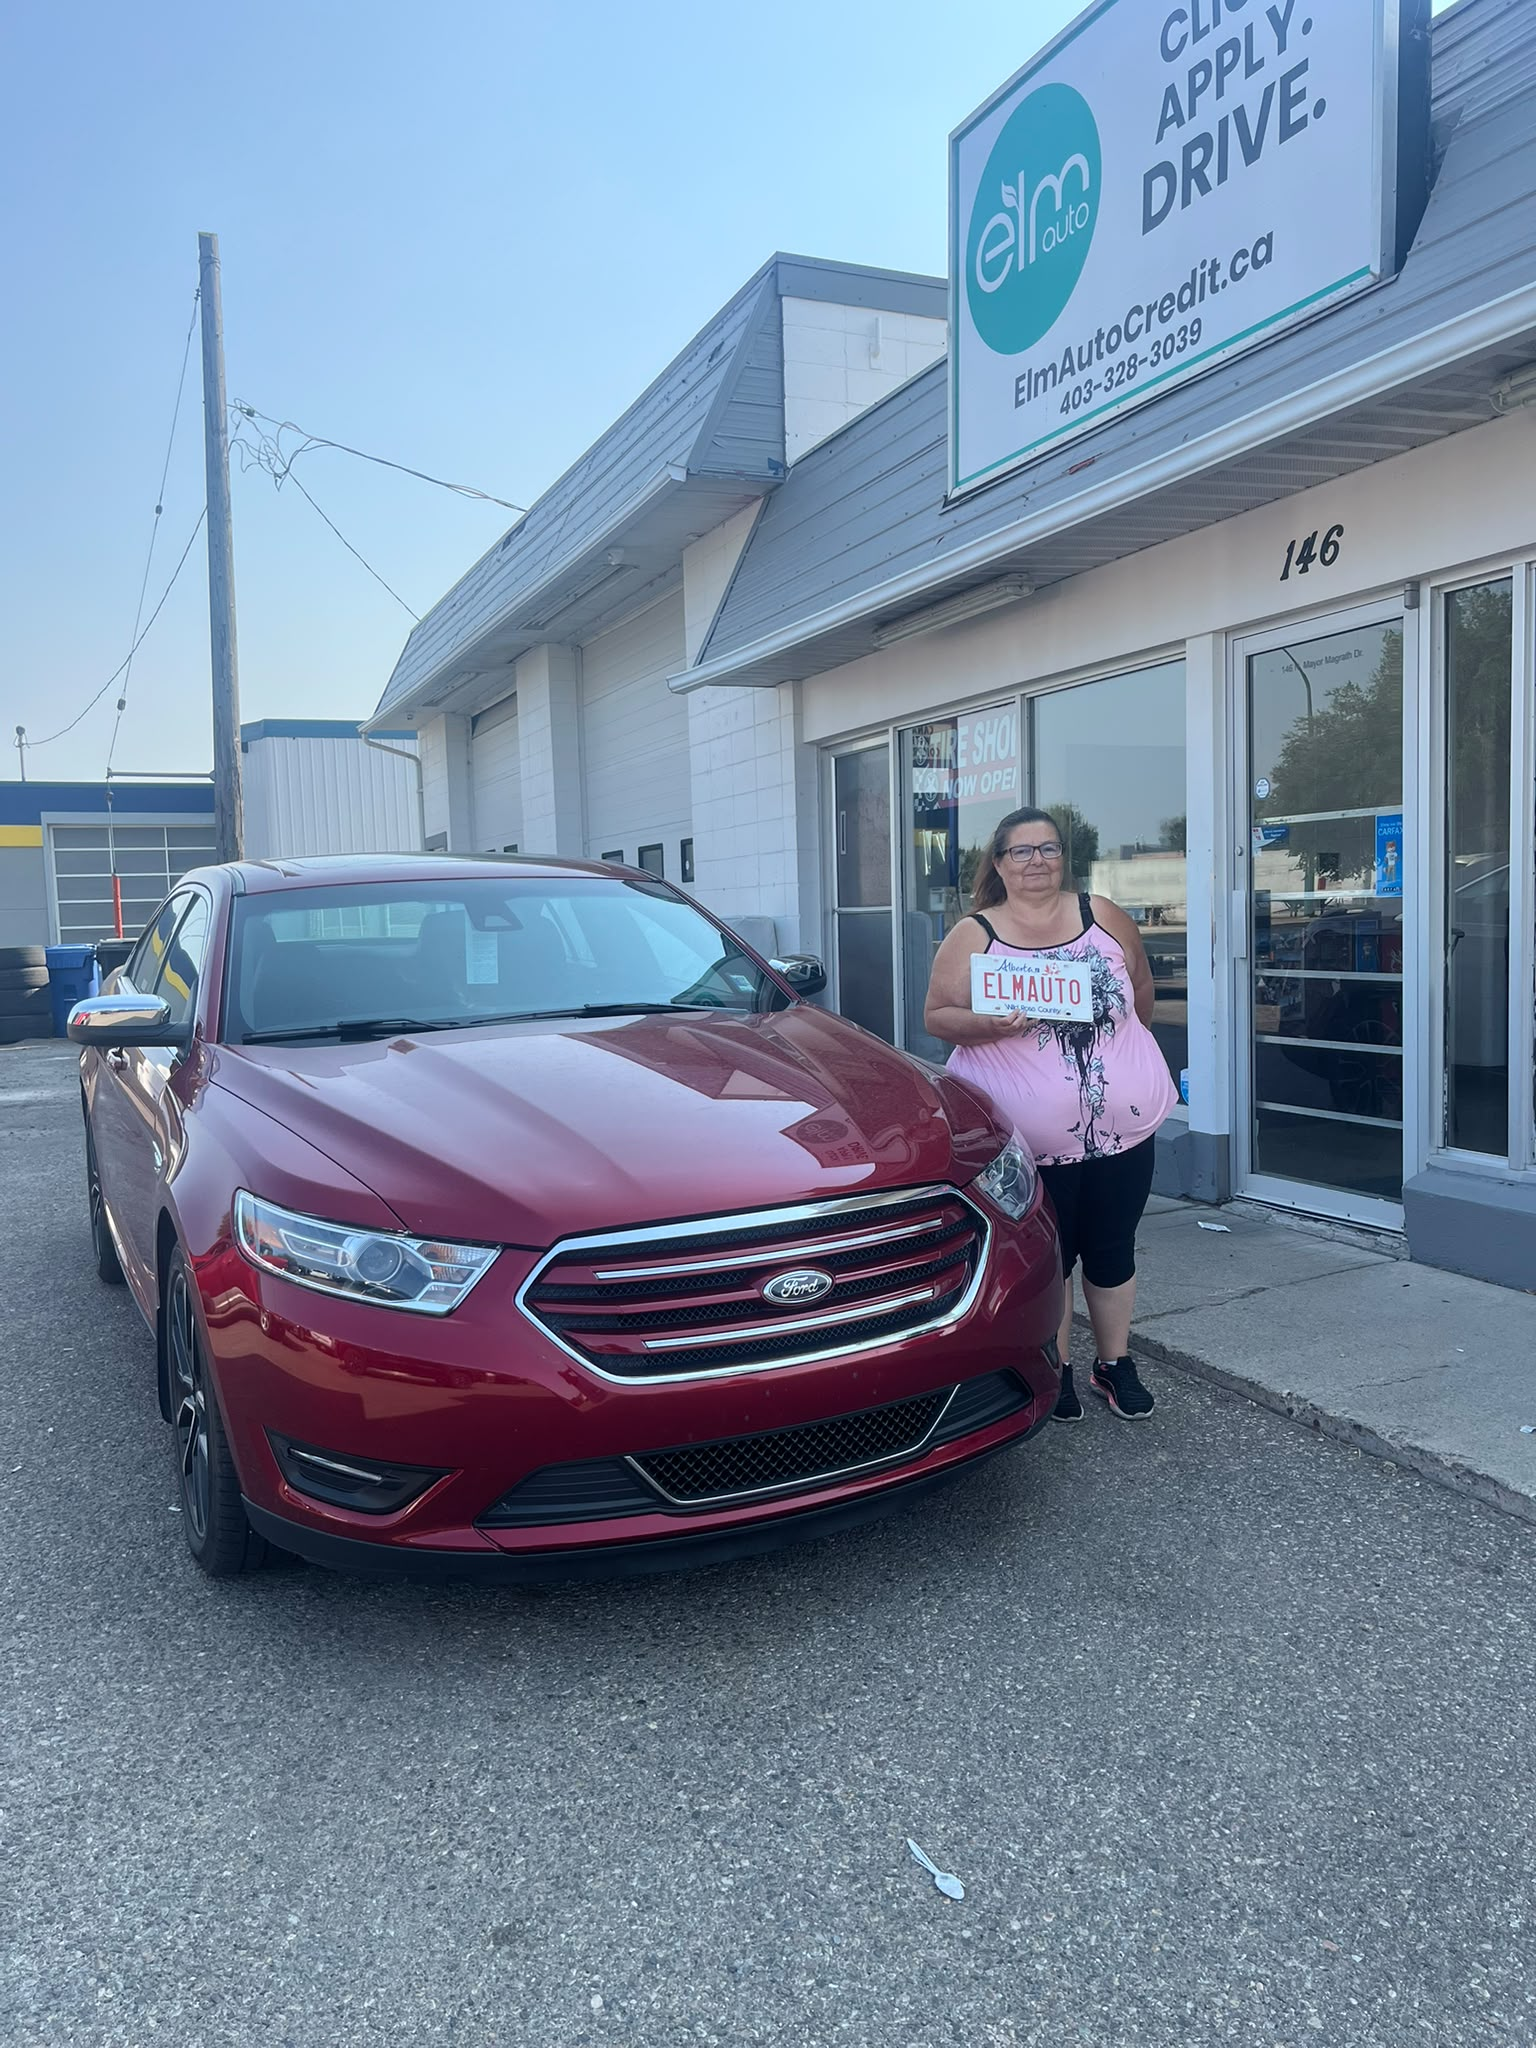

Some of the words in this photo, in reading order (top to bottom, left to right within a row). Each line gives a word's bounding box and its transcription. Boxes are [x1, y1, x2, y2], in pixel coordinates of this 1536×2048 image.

[1160, 0, 1249, 63] CLI
[1155, 0, 1313, 145] APPLY.
[1142, 57, 1327, 237] DRIVE.
[976, 152, 1090, 293] elm
[1042, 202, 1090, 252] auto
[1014, 231, 1274, 410] ElmAutoCredit.ca
[1059, 317, 1202, 415] 403-328-3039
[1279, 524, 1345, 581] 146
[1302, 659, 1324, 670] Mayor
[1325, 650, 1353, 665] Magrath
[929, 724, 969, 772] TIRE
[943, 774, 978, 801] NOW
[983, 971, 1081, 1005] ELMAUTO
[1038, 1006, 1062, 1015] Country
[780, 1276, 819, 1298] Ford
